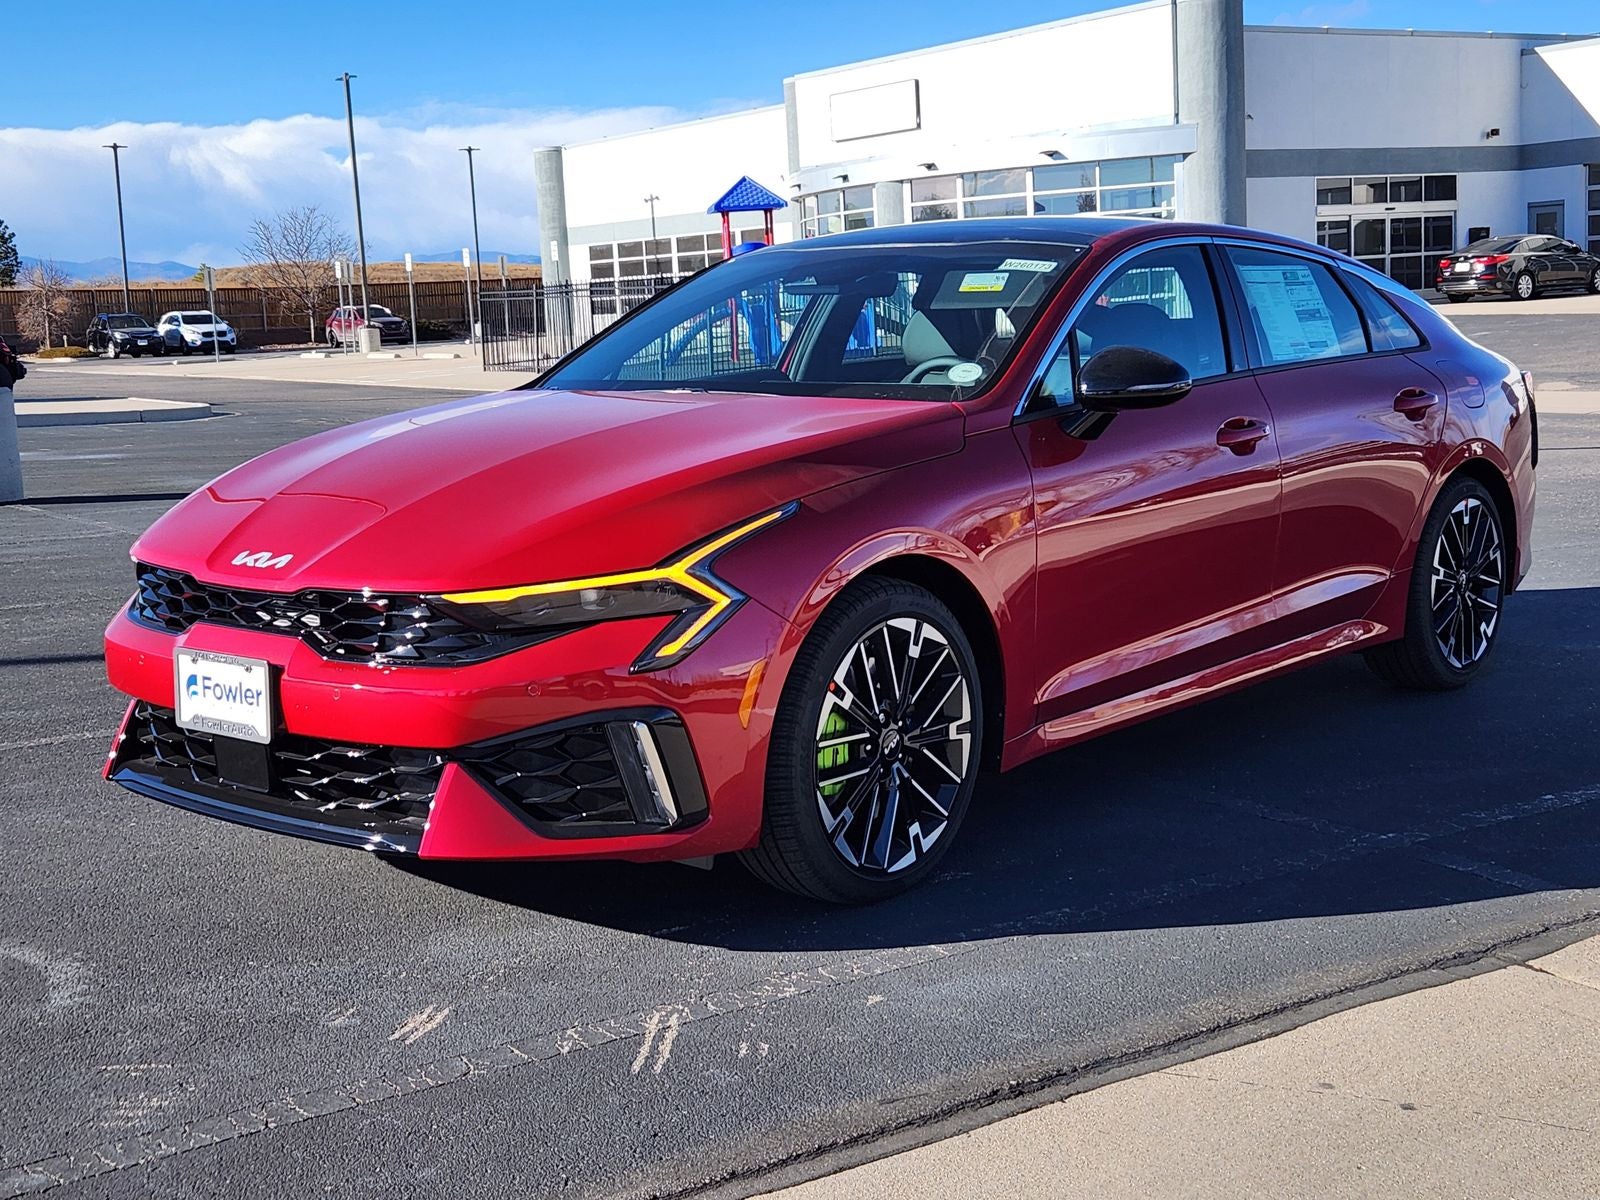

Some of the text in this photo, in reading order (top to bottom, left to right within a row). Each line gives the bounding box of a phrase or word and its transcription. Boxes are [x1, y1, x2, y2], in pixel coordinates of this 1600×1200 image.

[1004, 260, 1053, 270] W260173
[231, 550, 294, 569] KIA
[202, 675, 262, 707] Fowler
